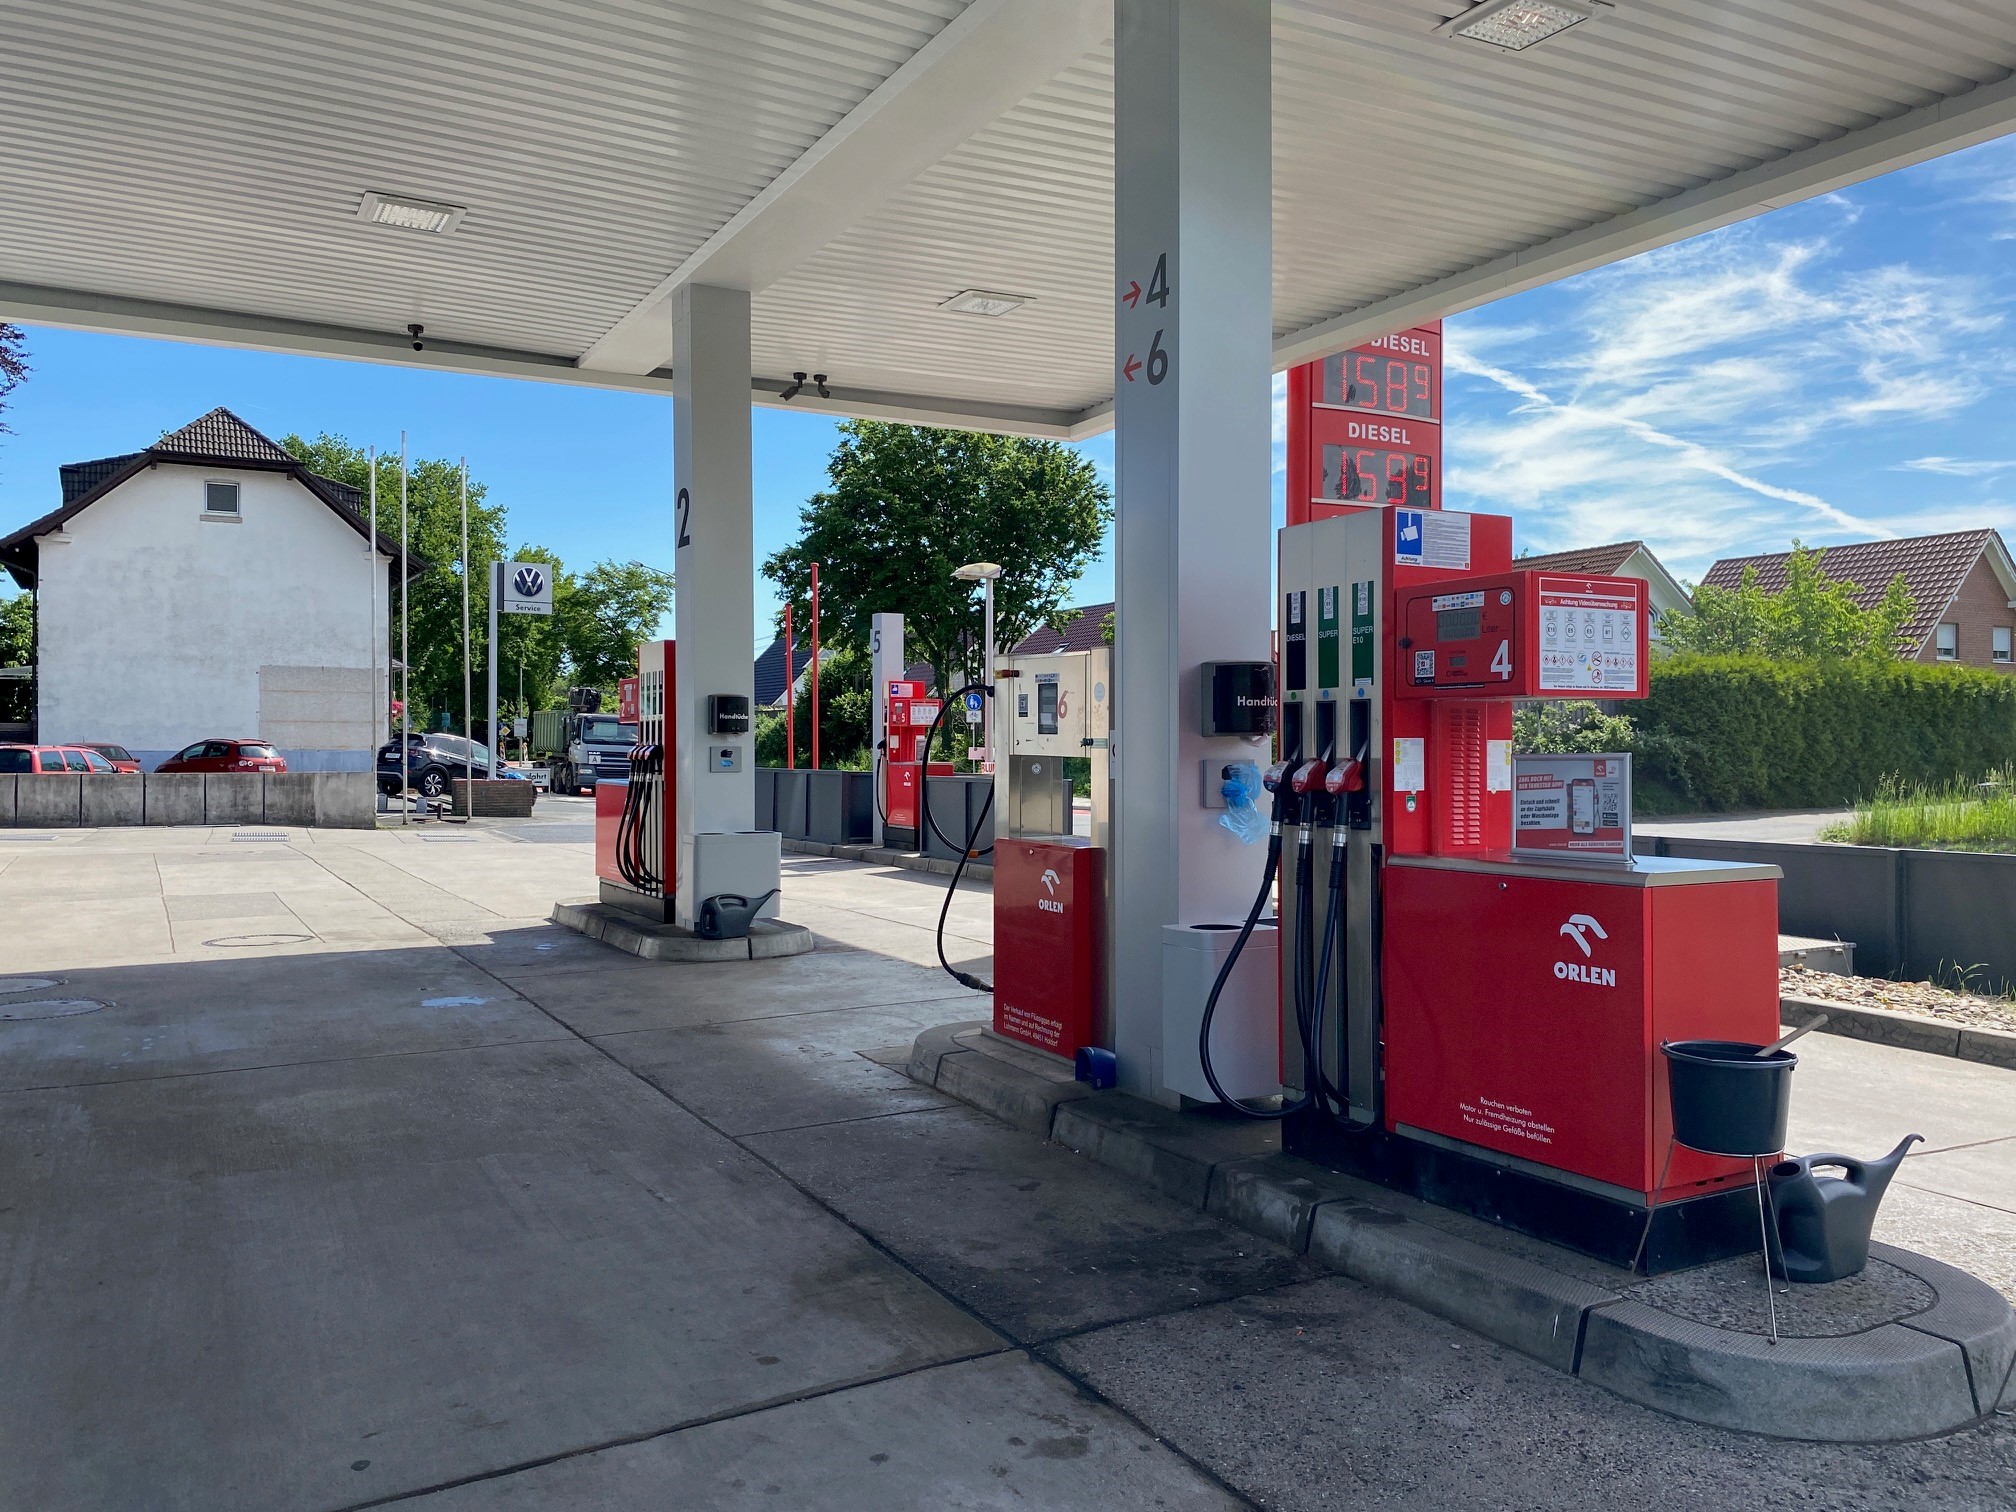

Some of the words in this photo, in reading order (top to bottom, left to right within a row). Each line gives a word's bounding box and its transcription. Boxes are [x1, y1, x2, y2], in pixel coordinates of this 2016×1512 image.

[1146, 252, 1170, 309] 4
[1146, 329, 1168, 386] 6
[1348, 422, 1411, 445] DIESEL
[677, 487, 691, 549] 2
[515, 603, 541, 612] Service
[1559, 598, 1579, 607] Achtung
[1286, 633, 1306, 642] DIESEL
[1318, 629, 1339, 639] SUPER
[1352, 625, 1374, 635] SUPER
[1481, 625, 1499, 634] Liter
[873, 630, 881, 654] 5
[1352, 636, 1364, 644] E10
[1490, 639, 1512, 680] 4
[1058, 689, 1069, 719] 6
[1237, 695, 1278, 707] Handtüc
[901, 713, 906, 723] 5
[592, 755, 597, 763] A
[529, 772, 547, 780] fahrt
[1038, 898, 1064, 914] ORLEN
[1553, 961, 1616, 987] ORLEN
[1480, 1096, 1505, 1110] Rauchen
[1505, 1104, 1532, 1117] verboten
[1459, 1102, 1477, 1114] Motor
[1477, 1108, 1484, 1116] u.
[1485, 1108, 1527, 1127] Fremdheizung
[1527, 1119, 1555, 1134] abstellen
[1463, 1113, 1475, 1124] Nur
[1475, 1118, 1502, 1132] zulässige
[1502, 1124, 1526, 1138] Gefäße
[1525, 1130, 1553, 1145] befüllen.
